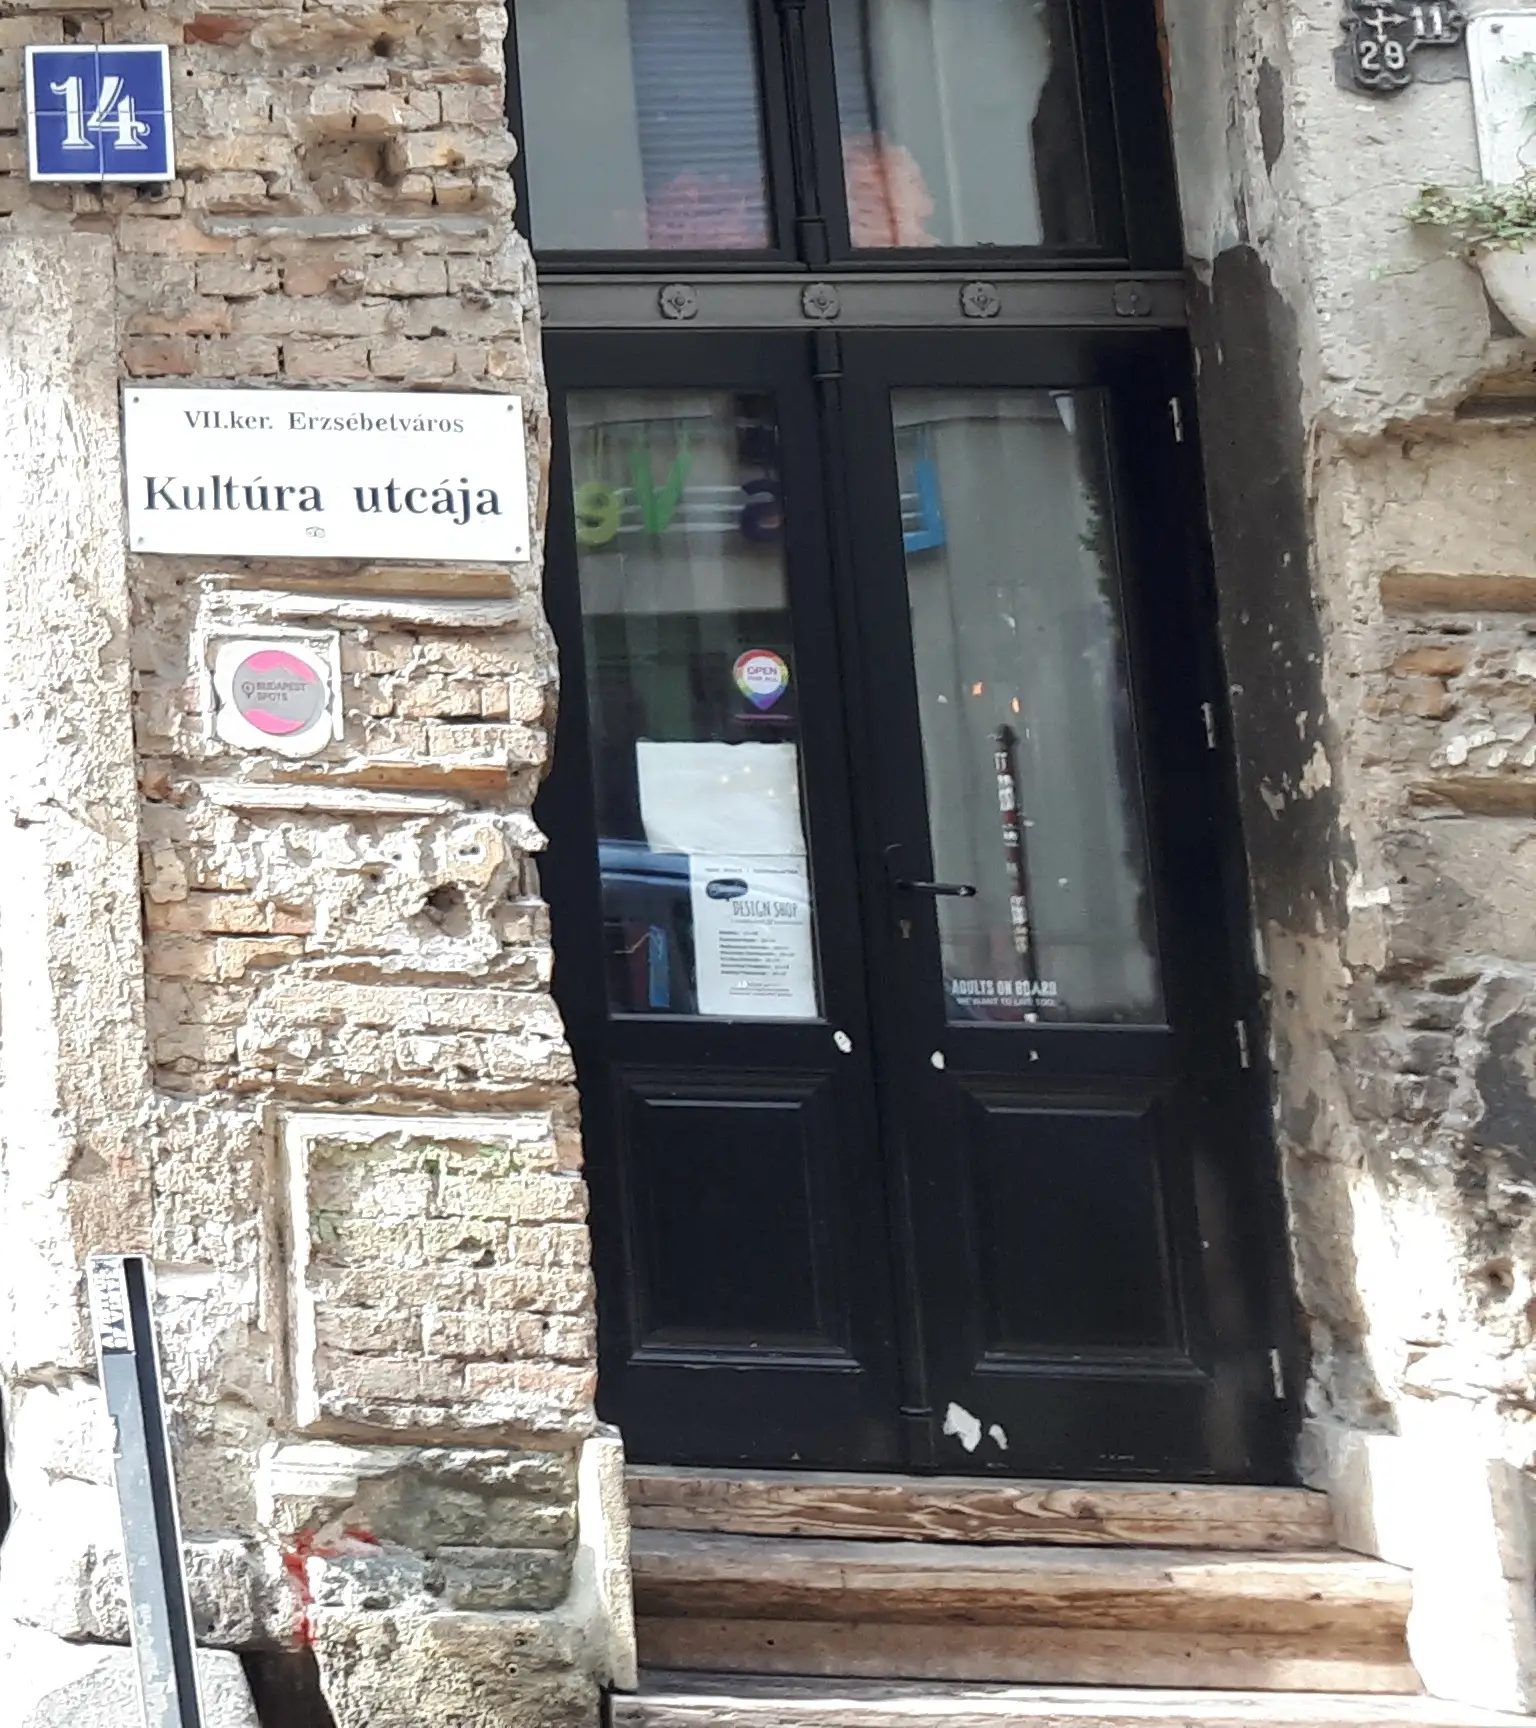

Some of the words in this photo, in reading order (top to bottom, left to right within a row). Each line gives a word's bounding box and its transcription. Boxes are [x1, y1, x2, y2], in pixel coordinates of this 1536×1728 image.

[1409, 2, 1443, 36] 11
[49, 75, 151, 150] 14
[288, 411, 466, 434] Erzsébetváros
[143, 474, 326, 512] Kultúra
[353, 477, 503, 526] utcája
[747, 666, 778, 676] OPEN
[256, 681, 307, 692] BUDAPEST
[256, 692, 289, 702] SPOTS
[732, 900, 771, 918] DESIGN
[773, 901, 798, 919] SHOP
[951, 979, 994, 996] ADULTS
[996, 980, 1013, 996] ON
[1014, 980, 1058, 997] BOARD
